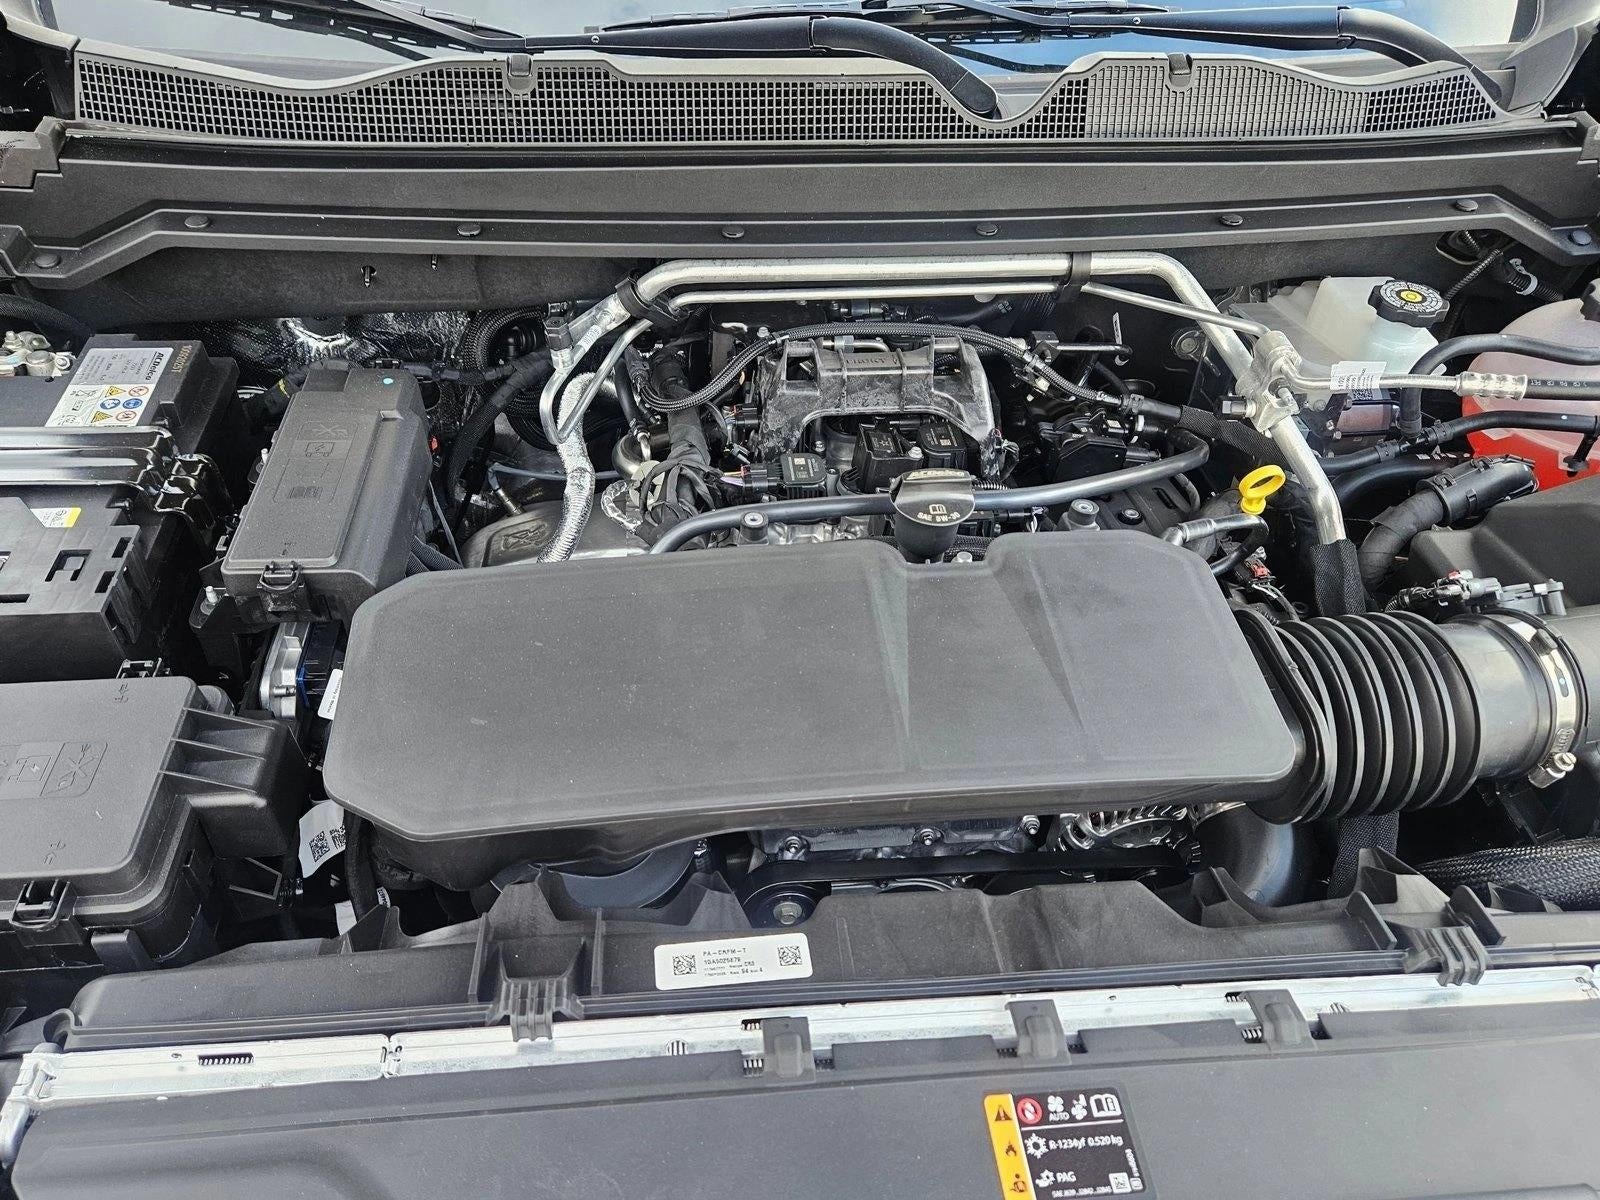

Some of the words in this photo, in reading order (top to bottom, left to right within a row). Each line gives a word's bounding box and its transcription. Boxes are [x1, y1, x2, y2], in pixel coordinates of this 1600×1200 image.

[145, 352, 164, 381] ACDelco
[917, 512, 932, 521] SAE
[1049, 1111, 1070, 1121] AUTO
[1048, 1136, 1086, 1150] R-1234yf
[1087, 1135, 1111, 1147] 0.520
[1111, 1134, 1124, 1147] kg
[1056, 1171, 1077, 1183] PAG
